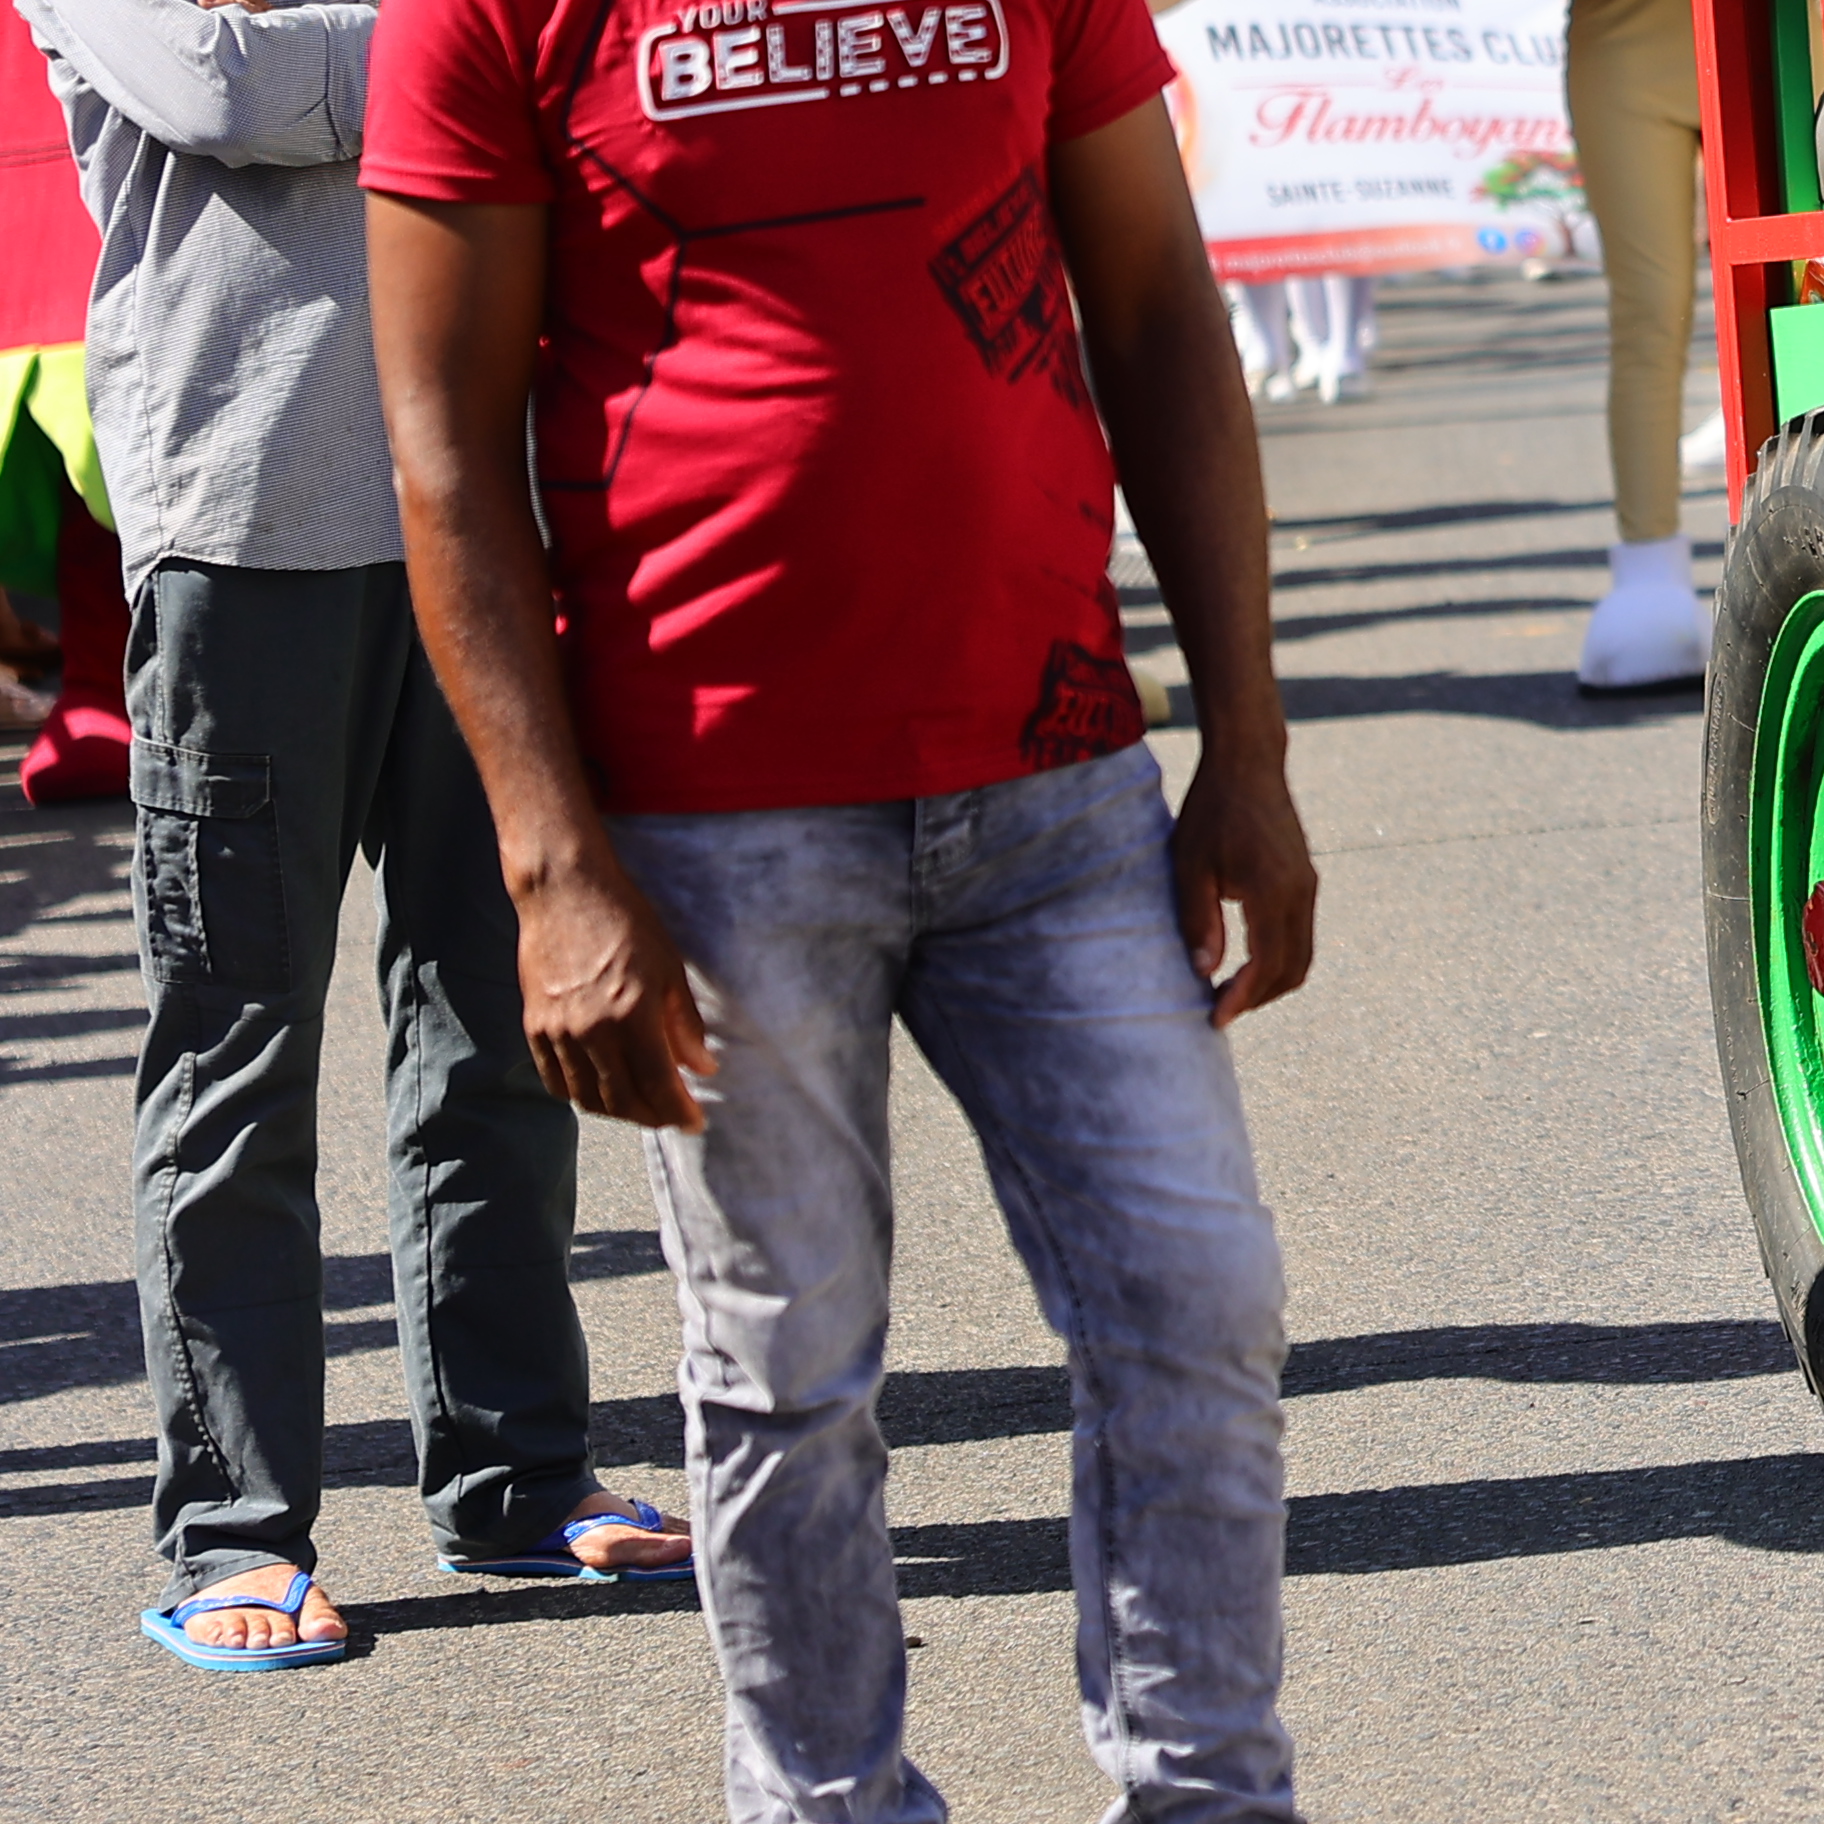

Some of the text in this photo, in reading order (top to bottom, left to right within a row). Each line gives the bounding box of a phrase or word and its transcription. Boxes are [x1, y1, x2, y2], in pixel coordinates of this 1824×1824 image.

[657, 4, 993, 102] BELIEVE
[1205, 22, 1564, 66] MAJORETTES CLU
